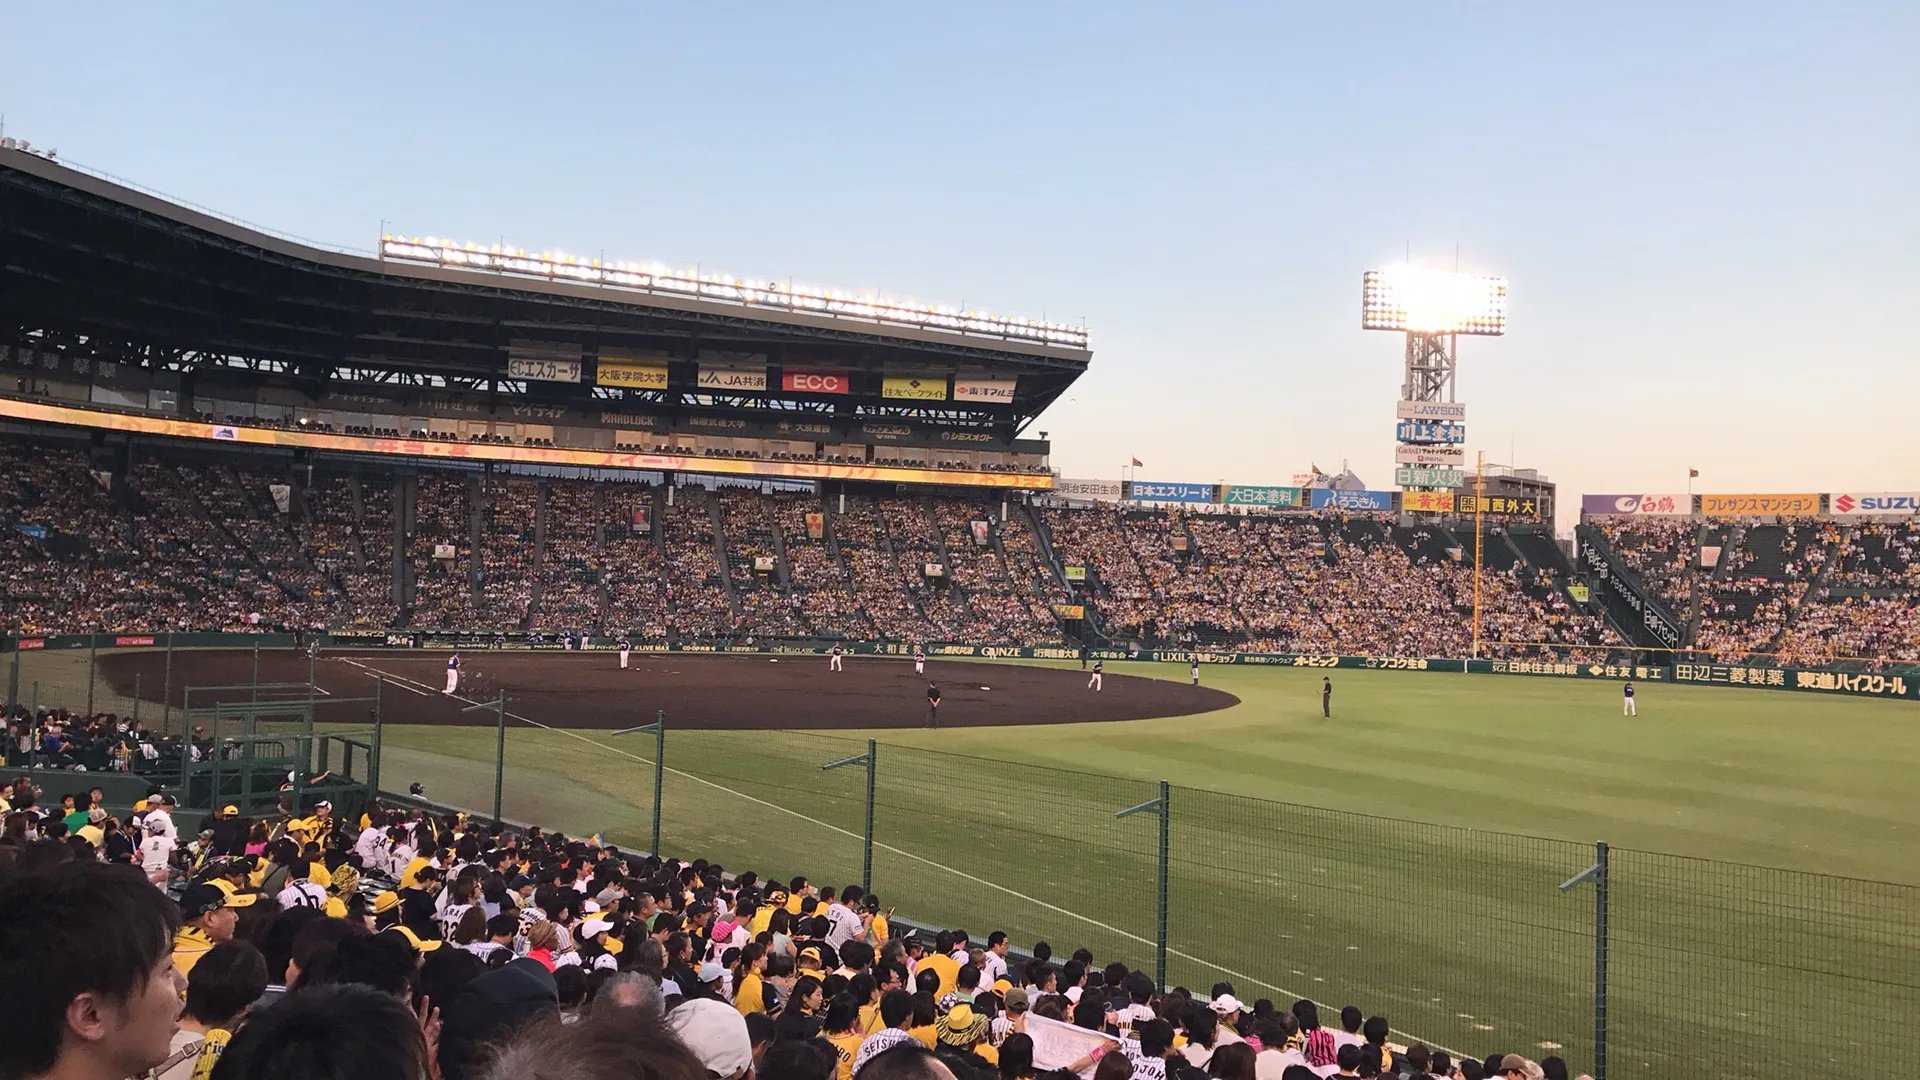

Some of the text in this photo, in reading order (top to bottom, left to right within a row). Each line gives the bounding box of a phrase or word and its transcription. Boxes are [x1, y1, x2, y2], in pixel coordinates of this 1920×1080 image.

[599, 369, 667, 385] 大阪学院大学
[724, 374, 766, 387] JA共済
[793, 374, 838, 391] ECC
[884, 387, 947, 399] 住友ベークライト
[969, 387, 1014, 398] 東洋アルミ
[1413, 405, 1464, 417] LAWSON
[1400, 424, 1464, 442] 川上塗料
[1398, 469, 1464, 486] 日新火災
[1059, 482, 1120, 499] 明治安田生命
[1133, 484, 1211, 501] 日本エスリード
[1230, 488, 1292, 505] 大日本塗料
[1339, 497, 1379, 509] ろうきん
[1418, 493, 1453, 511] 黄桜
[1641, 496, 1675, 513] 白鶴
[1707, 498, 1813, 512] プレサンスマンション
[1293, 656, 1339, 667] オービック
[1380, 658, 1428, 670] フコク生命
[1605, 666, 1662, 679] 住友電工
[1676, 664, 1785, 686] 田辺三菱製薬
[1797, 671, 1907, 695] 東進ハイスクール
